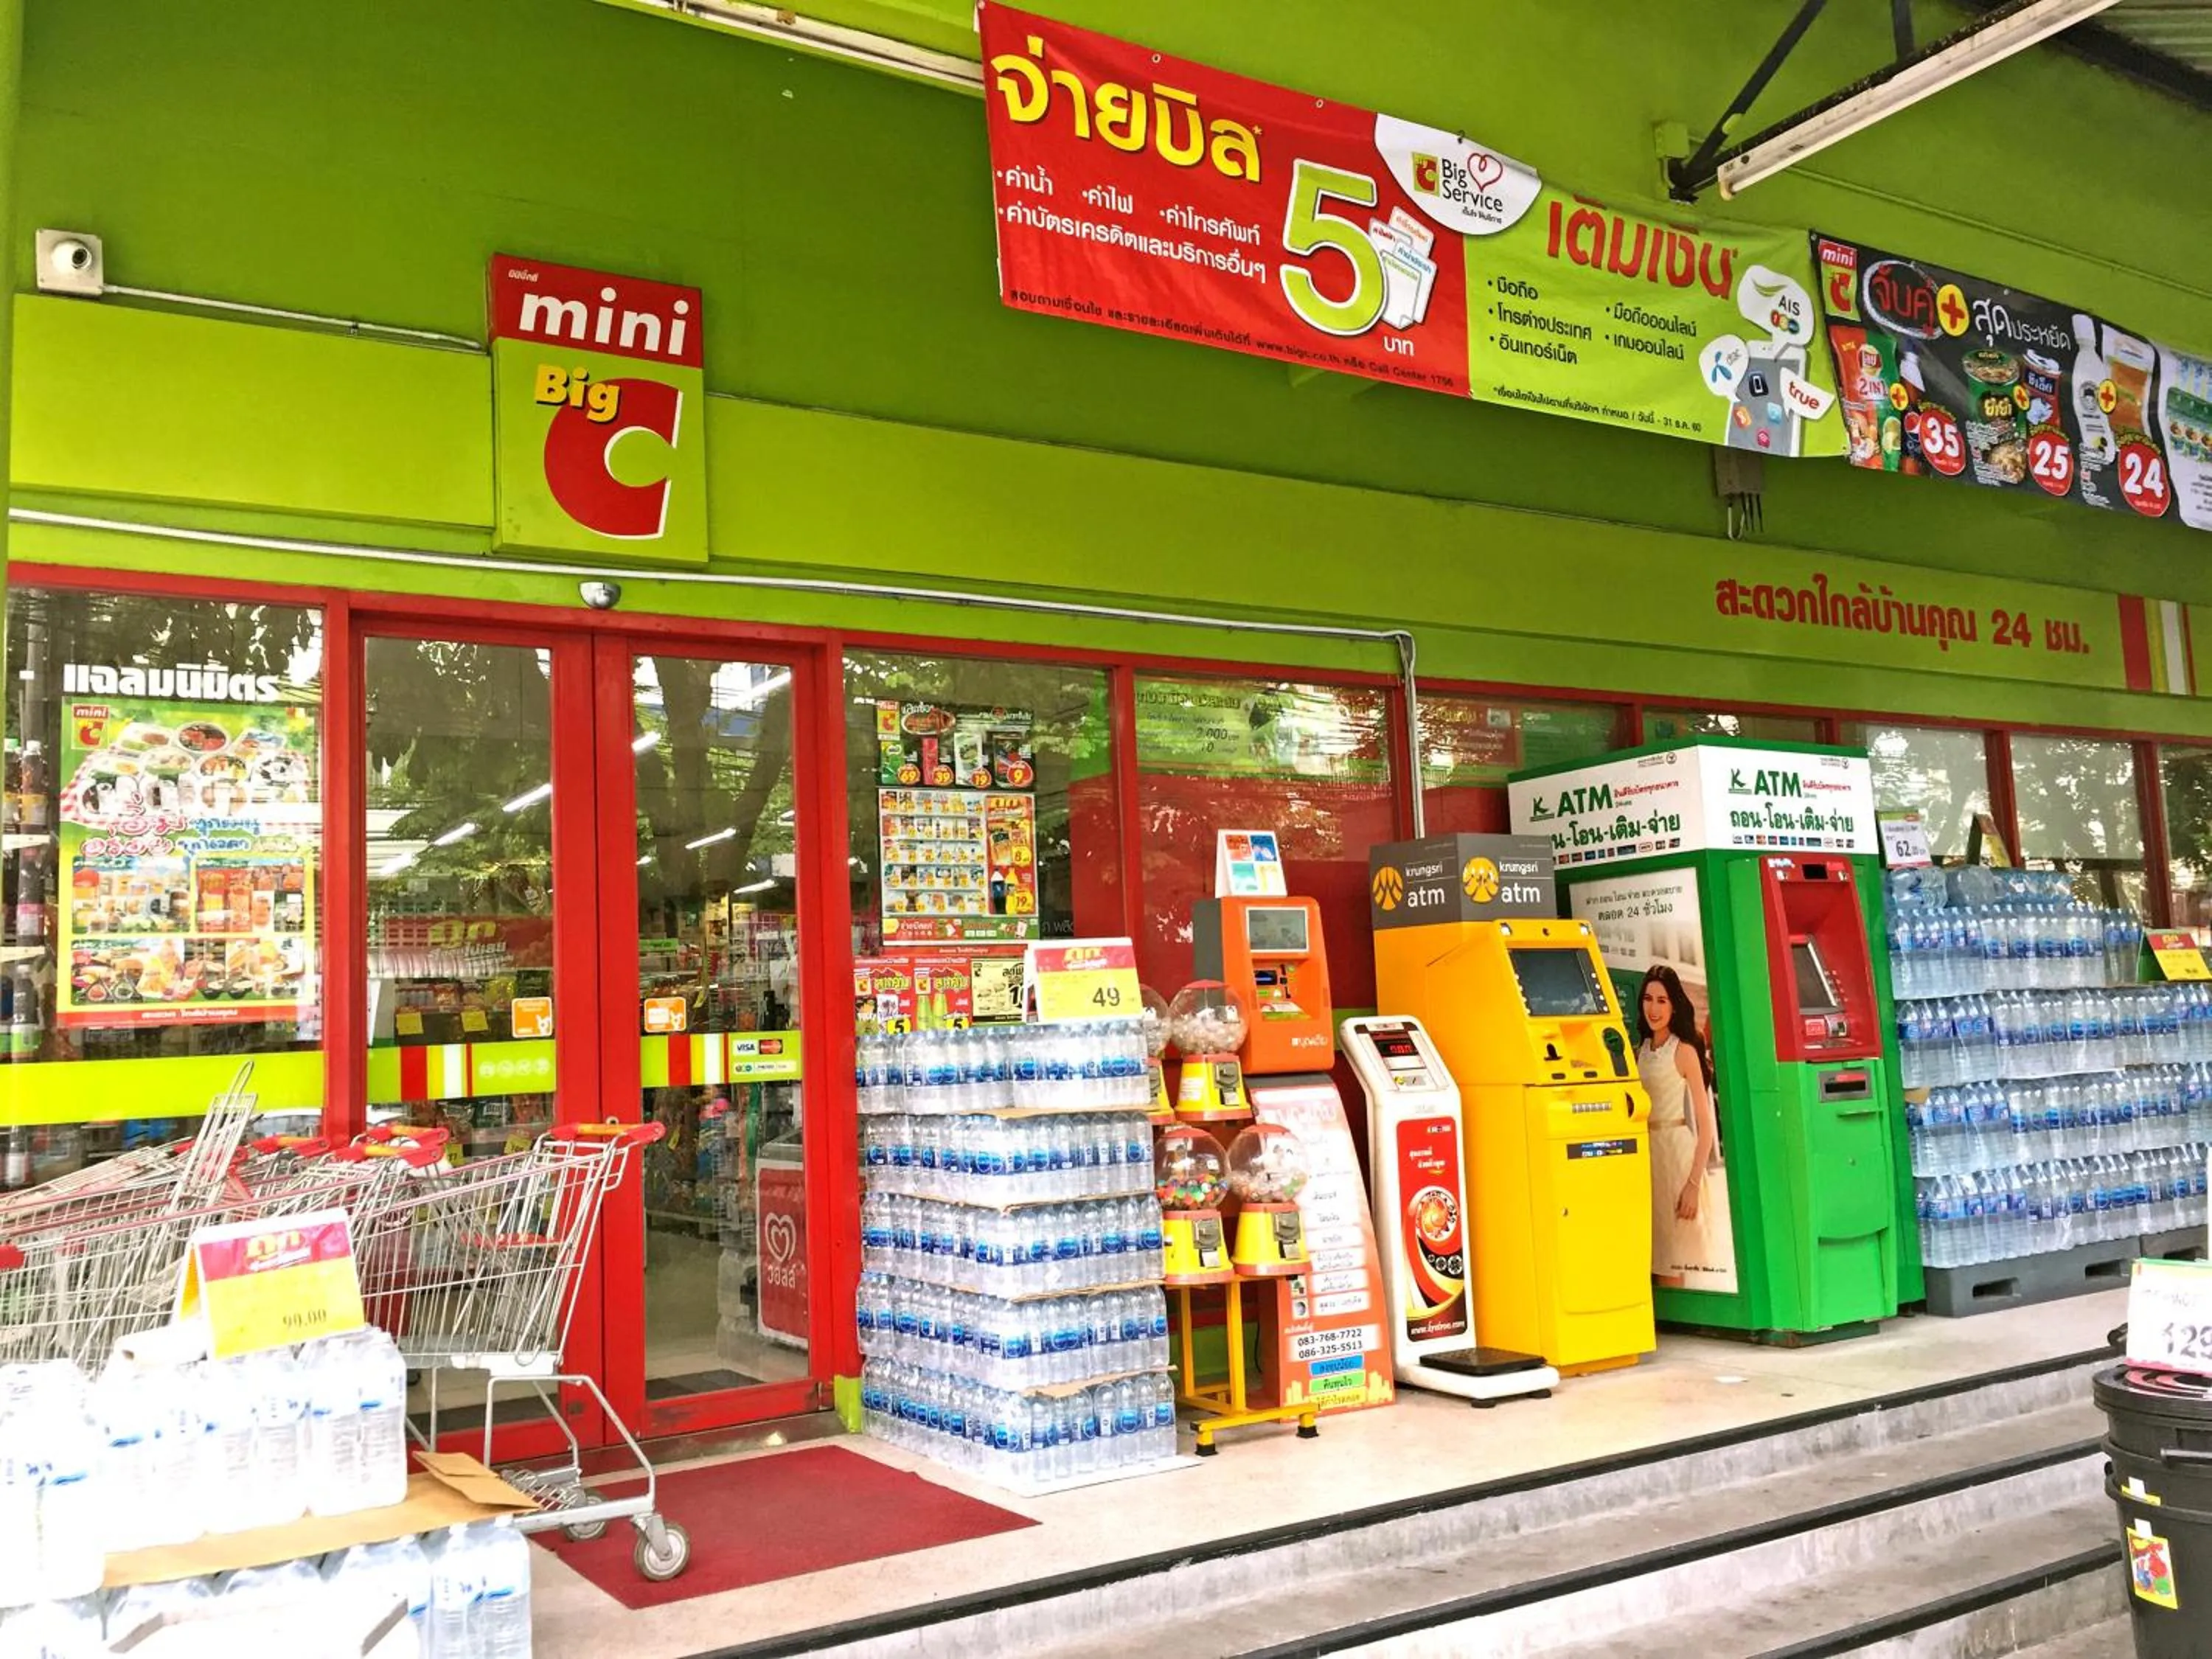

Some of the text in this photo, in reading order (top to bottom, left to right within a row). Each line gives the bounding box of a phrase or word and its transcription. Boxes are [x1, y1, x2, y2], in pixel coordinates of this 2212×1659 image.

[991, 35, 1262, 183] จ่ายบิล
[1442, 158, 1467, 188] Big
[1006, 164, 1261, 246] ค่าน้ำ ค่าไฟ ค่าโทรศัพท์
[1443, 181, 1503, 212] Service
[1006, 198, 1267, 283] ค่าบัตรเครดิตและบริการอื่นๆ
[1279, 157, 1389, 336] 5
[1822, 247, 1854, 267] mini
[519, 287, 689, 355] mini
[1497, 276, 1697, 338] มือถือ มือถือออนไลน์
[1778, 295, 1800, 316] AIS
[1498, 302, 1593, 341] โทรต่างประเทศ
[1384, 335, 1414, 356] บาท
[1498, 331, 1685, 366] อินเทอร์เน็ต เกมออนไลน์
[1369, 362, 1389, 374] Call
[1394, 367, 1426, 380] Center
[535, 364, 621, 422] Big
[1789, 381, 1820, 409] true
[1924, 417, 1960, 458] 35
[543, 378, 684, 540] C
[2034, 440, 2068, 479] 25
[2124, 453, 2163, 498] 24
[1715, 573, 2089, 654] สะดวกใกล้บ้านคุณ 24 ชม.
[1754, 769, 1802, 798] ATM
[1557, 784, 1613, 818] ATM
[1552, 810, 1680, 849] น-โอน-เติม-จ่าย
[1896, 841, 1912, 857] 62
[1405, 861, 1443, 877] krungsri
[1500, 860, 1538, 875] krungsri
[1407, 886, 1445, 908] atm
[1501, 883, 1540, 903] atm
[1627, 906, 1639, 918] 24
[1092, 987, 1121, 1007] 49
[1298, 1329, 1362, 1347] 083-768-7722
[1298, 1340, 1363, 1359] 086-325-5513
